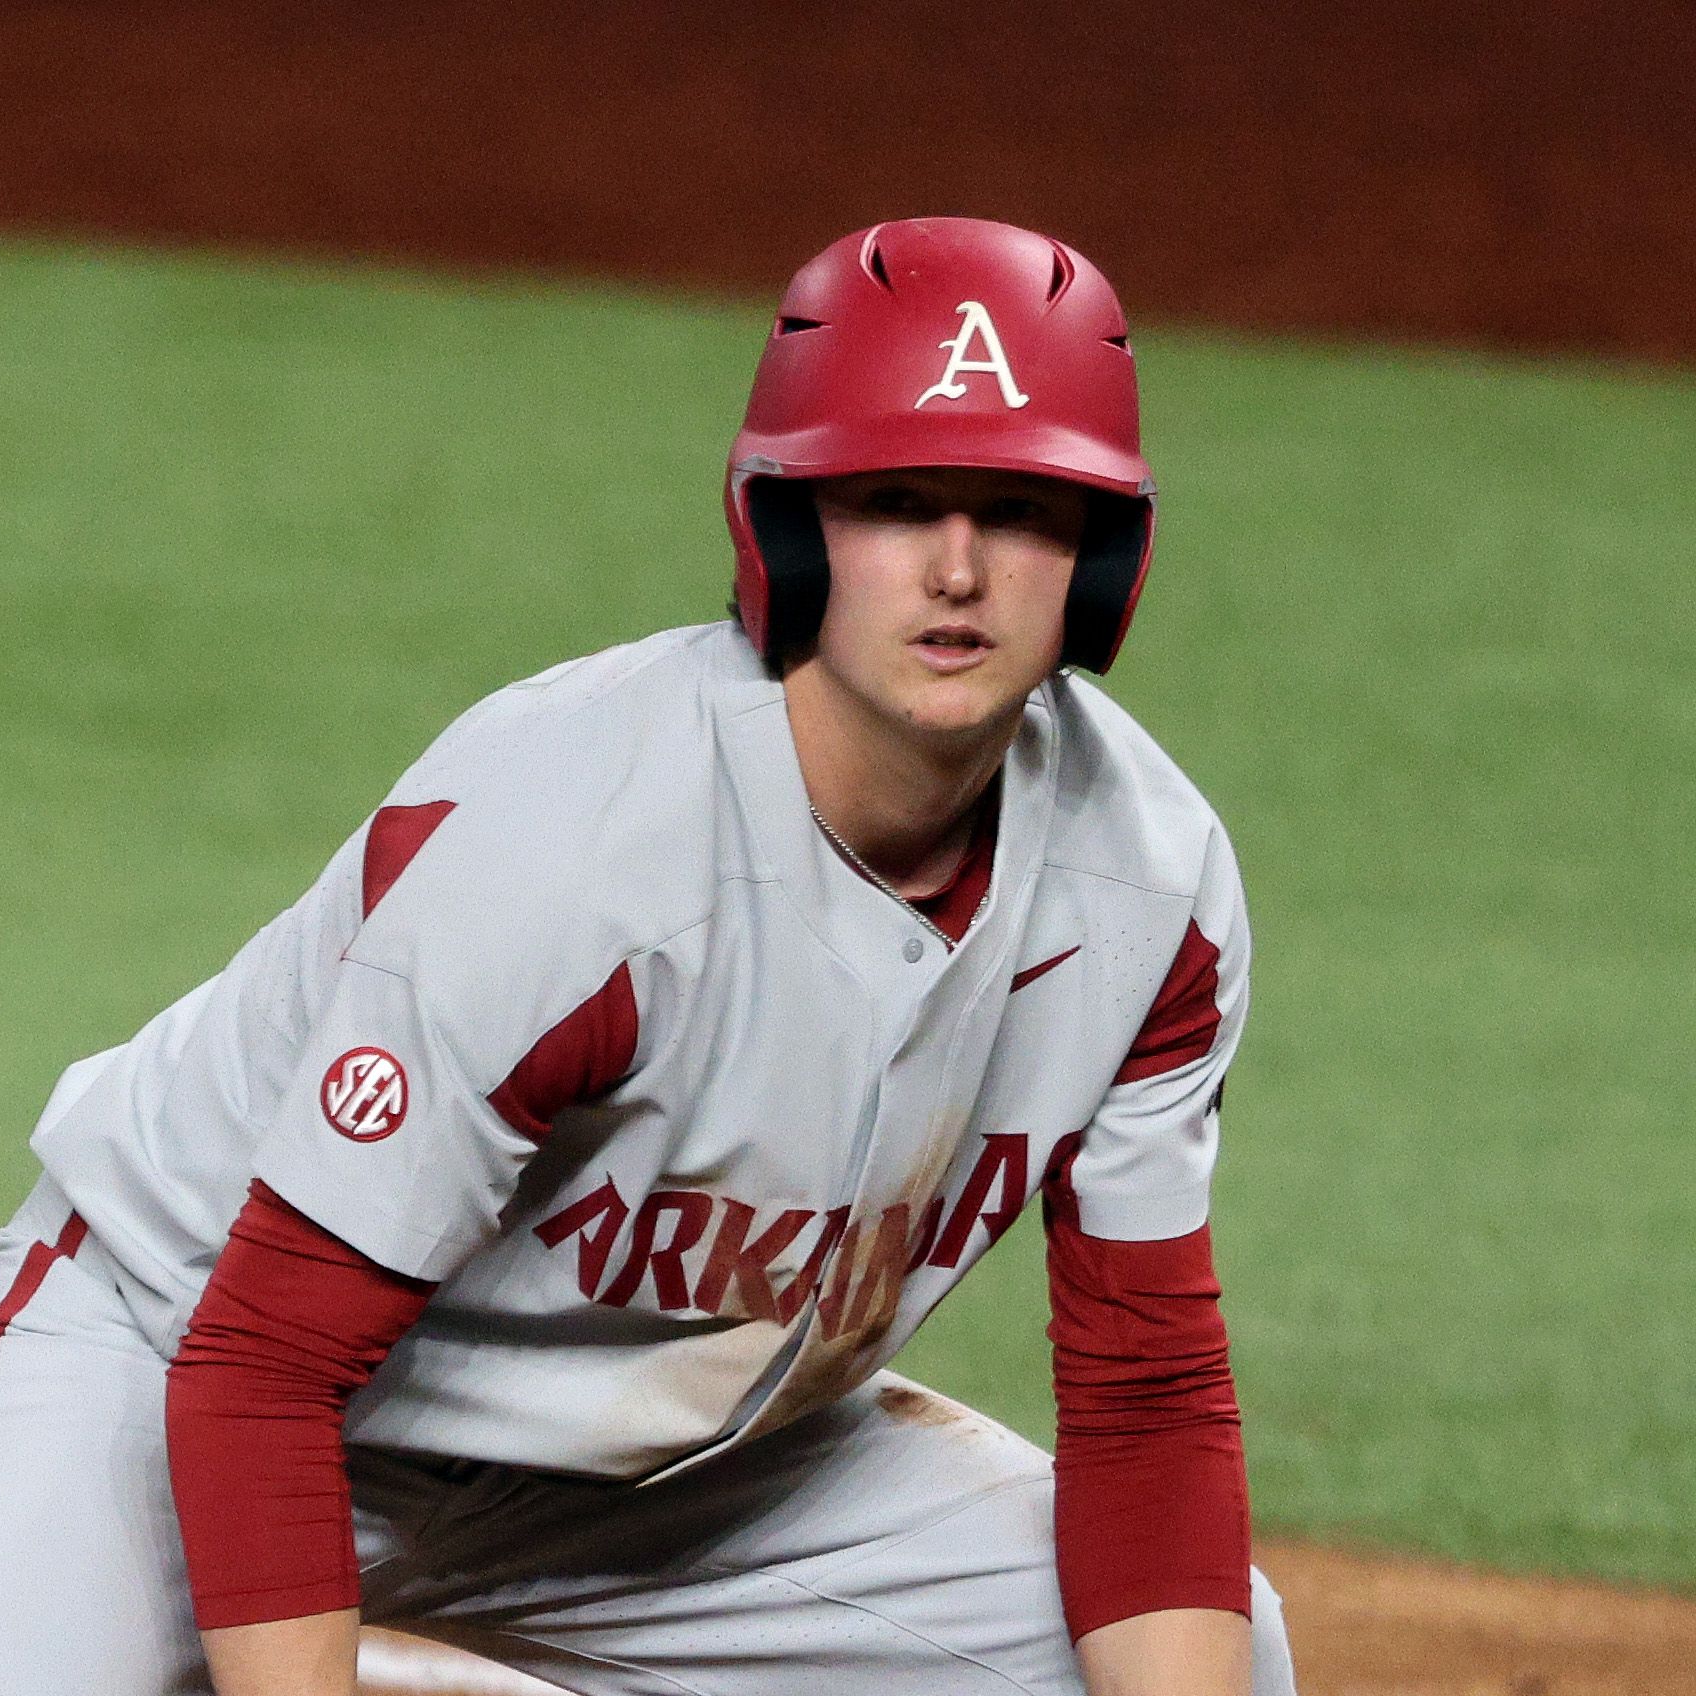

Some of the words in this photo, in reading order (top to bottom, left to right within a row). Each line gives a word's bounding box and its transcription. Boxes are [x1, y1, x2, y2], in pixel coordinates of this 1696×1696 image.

[914, 300, 1030, 410] A
[326, 1053, 404, 1135] SEC
[532, 1128, 1082, 1341] ARKANA
